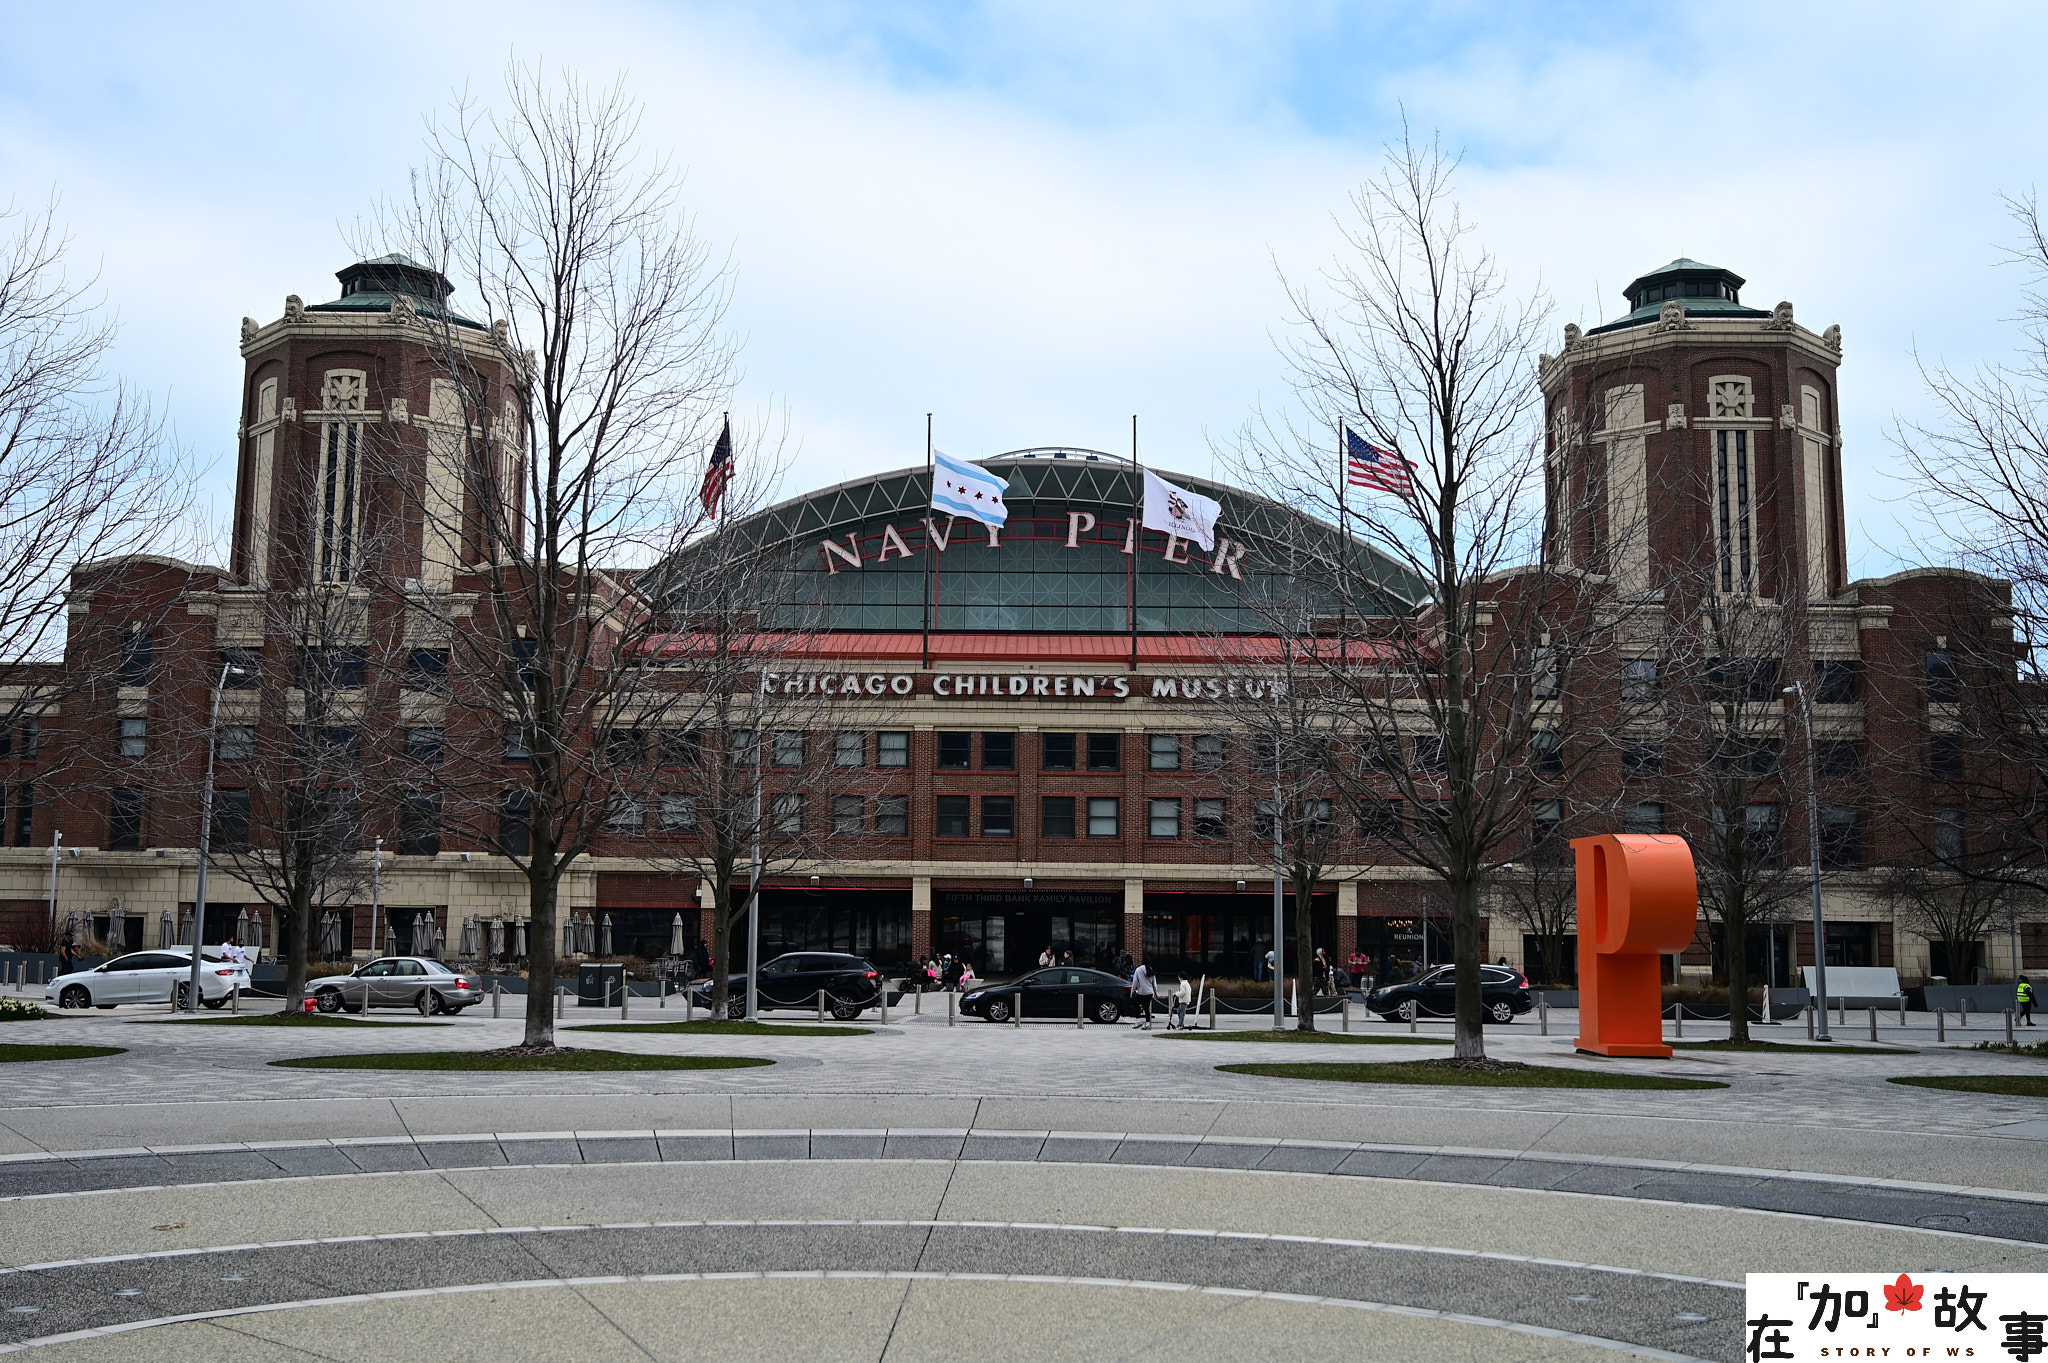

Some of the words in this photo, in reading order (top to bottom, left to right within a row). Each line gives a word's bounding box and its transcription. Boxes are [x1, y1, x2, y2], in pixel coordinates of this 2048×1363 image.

[819, 514, 1002, 576] NAVY
[1064, 511, 1245, 581] PIER
[763, 673, 914, 695] CHICAGO
[932, 674, 1130, 698] CHILDREN'S
[945, 894, 973, 902] FIFTH
[974, 894, 1003, 902] THIRD
[1005, 894, 1031, 903] BANK
[1033, 894, 1066, 904] FAMILY
[1068, 895, 1112, 904] PAVILION
[1393, 933, 1424, 941] REUNION
